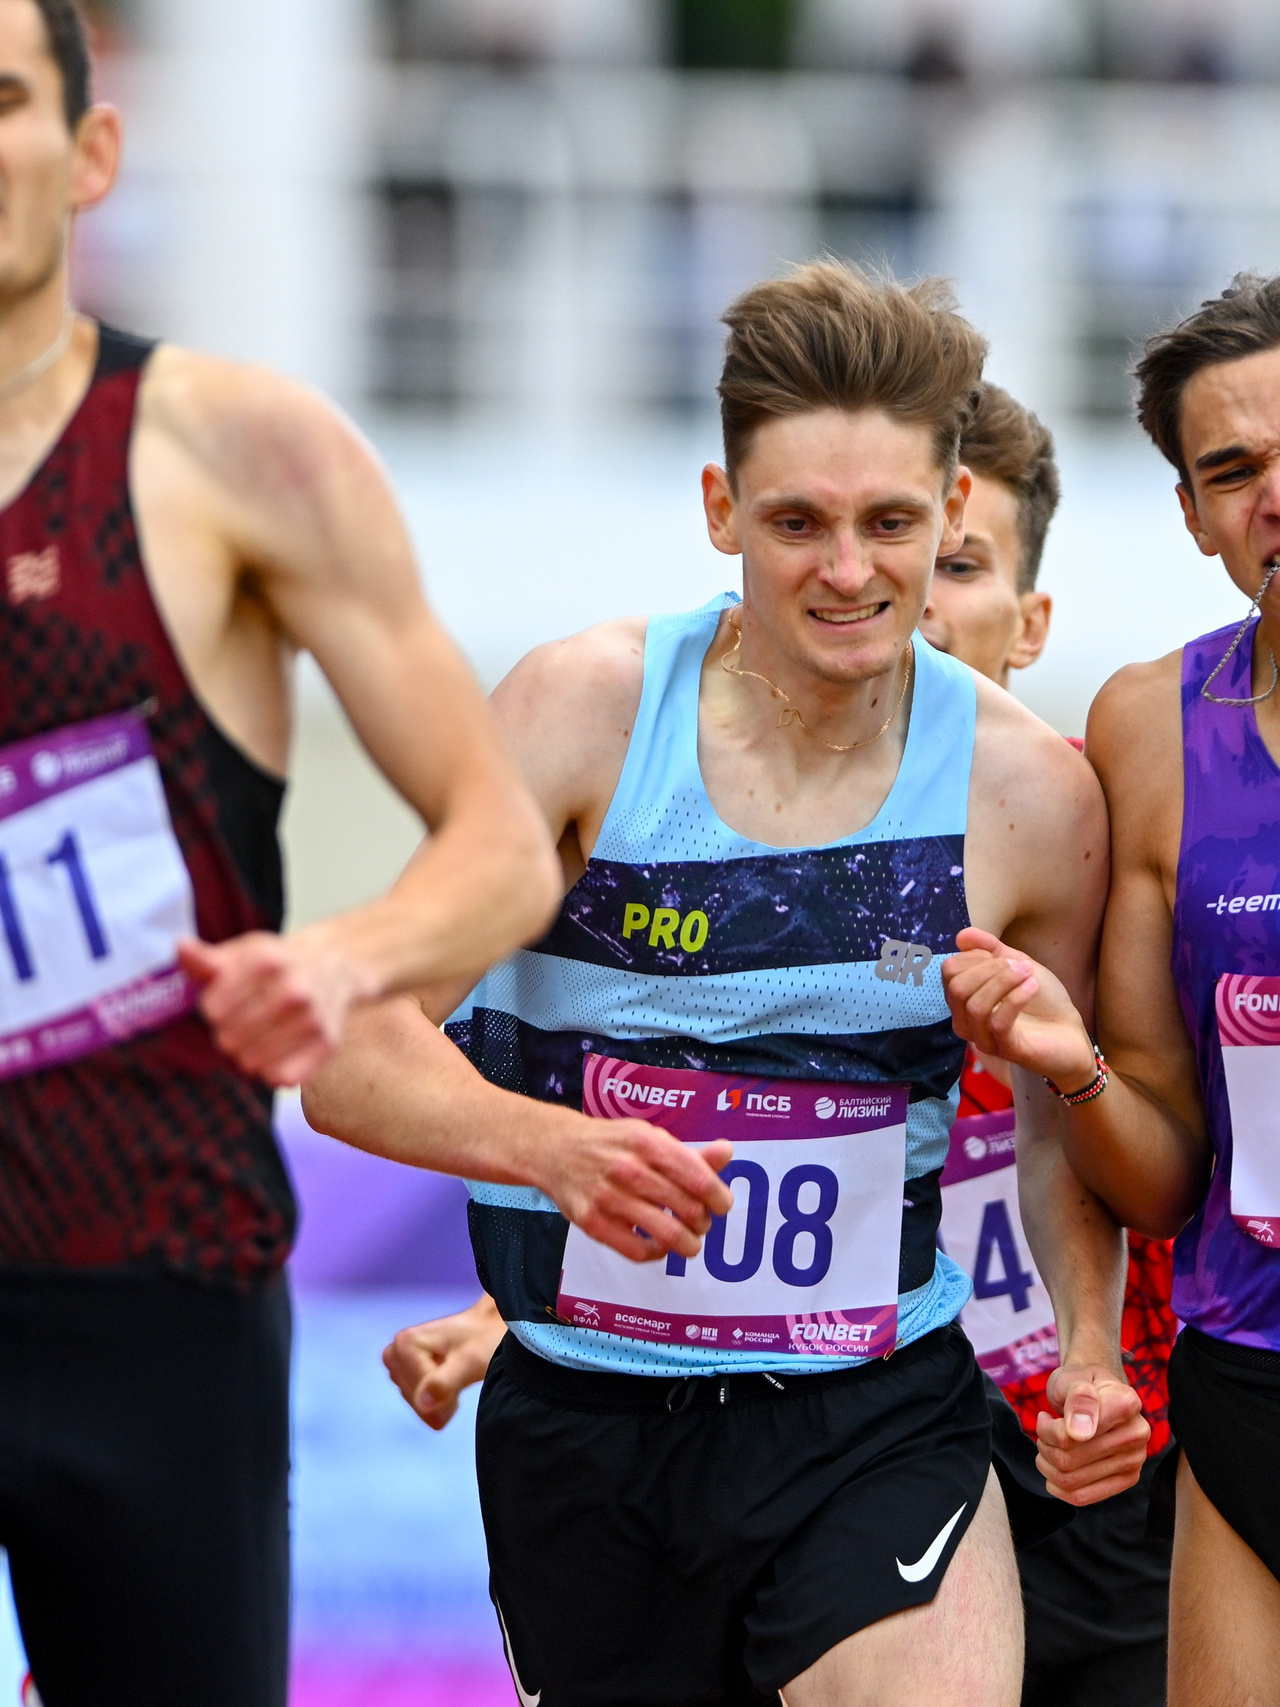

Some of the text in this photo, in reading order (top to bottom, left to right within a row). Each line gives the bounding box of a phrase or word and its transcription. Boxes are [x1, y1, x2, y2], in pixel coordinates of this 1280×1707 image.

[622, 902, 709, 953] PRO
[602, 1078, 696, 1109] FONBET
[839, 1096, 892, 1106] БАЛТИЙСКИЙ
[746, 1093, 791, 1112] ПСБ
[837, 1104, 891, 1119] ЛИЗИНГ
[573, 1314, 599, 1327] ВФЛА
[744, 1331, 780, 1339] КОМАНДА
[790, 1323, 878, 1342] FONBET
[788, 1342, 869, 1353] КУБОК РОССИИ
